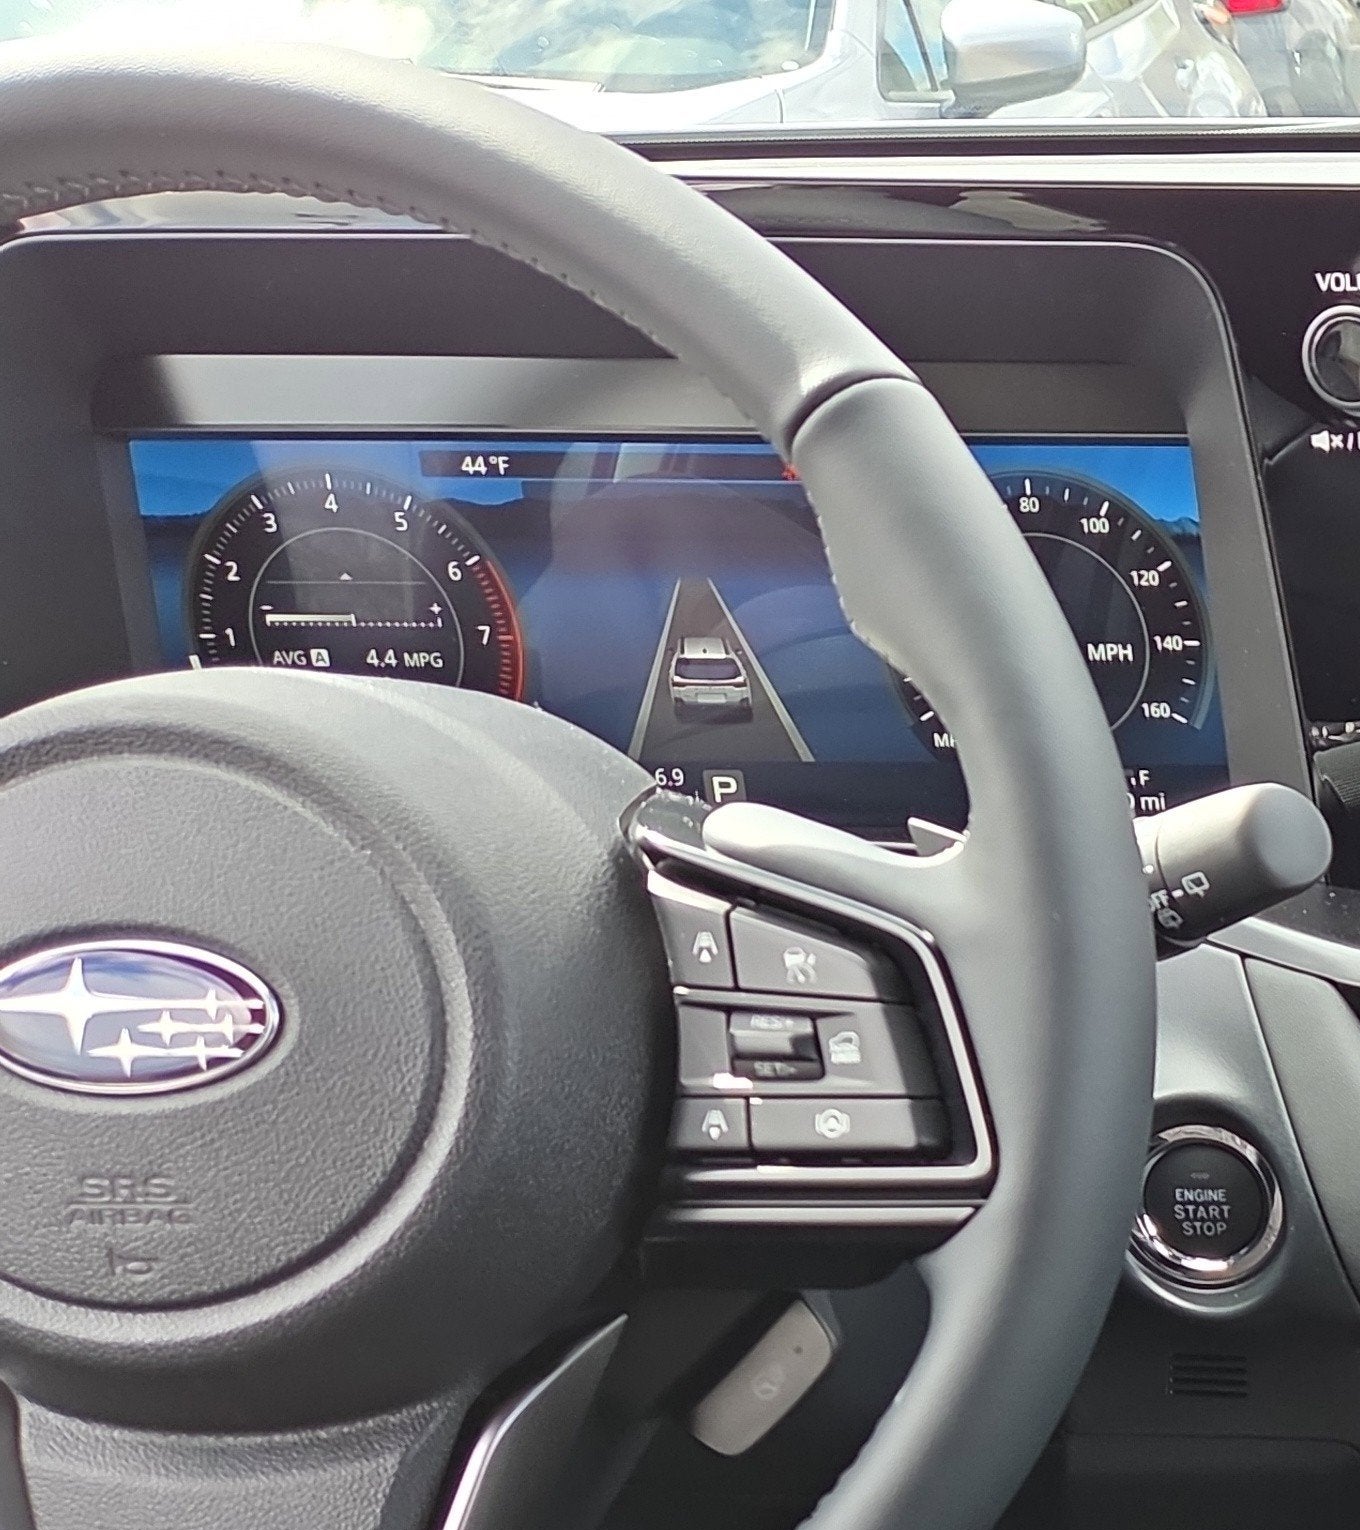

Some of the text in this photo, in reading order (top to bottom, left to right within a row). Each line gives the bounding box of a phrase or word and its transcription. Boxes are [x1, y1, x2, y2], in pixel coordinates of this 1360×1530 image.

[461, 456, 509, 475] 44°F
[325, 494, 338, 512] 4
[1020, 497, 1039, 513] 80
[263, 513, 278, 533] 3
[394, 512, 408, 532] 5
[1080, 517, 1110, 534] 100
[227, 562, 241, 582] 2
[448, 561, 462, 581] 6
[1130, 569, 1160, 586] 120
[225, 628, 237, 647] 1
[478, 625, 491, 646] 7
[1154, 635, 1183, 651] 140
[273, 650, 306, 665] AVG
[367, 649, 443, 668] 4.4 MPG
[1087, 643, 1133, 663] MPH
[1142, 702, 1171, 719] 160
[712, 777, 738, 803] P
[1175, 1188, 1227, 1202] ENGINE
[1174, 1204, 1230, 1220] START
[1182, 1221, 1227, 1236] STOP
